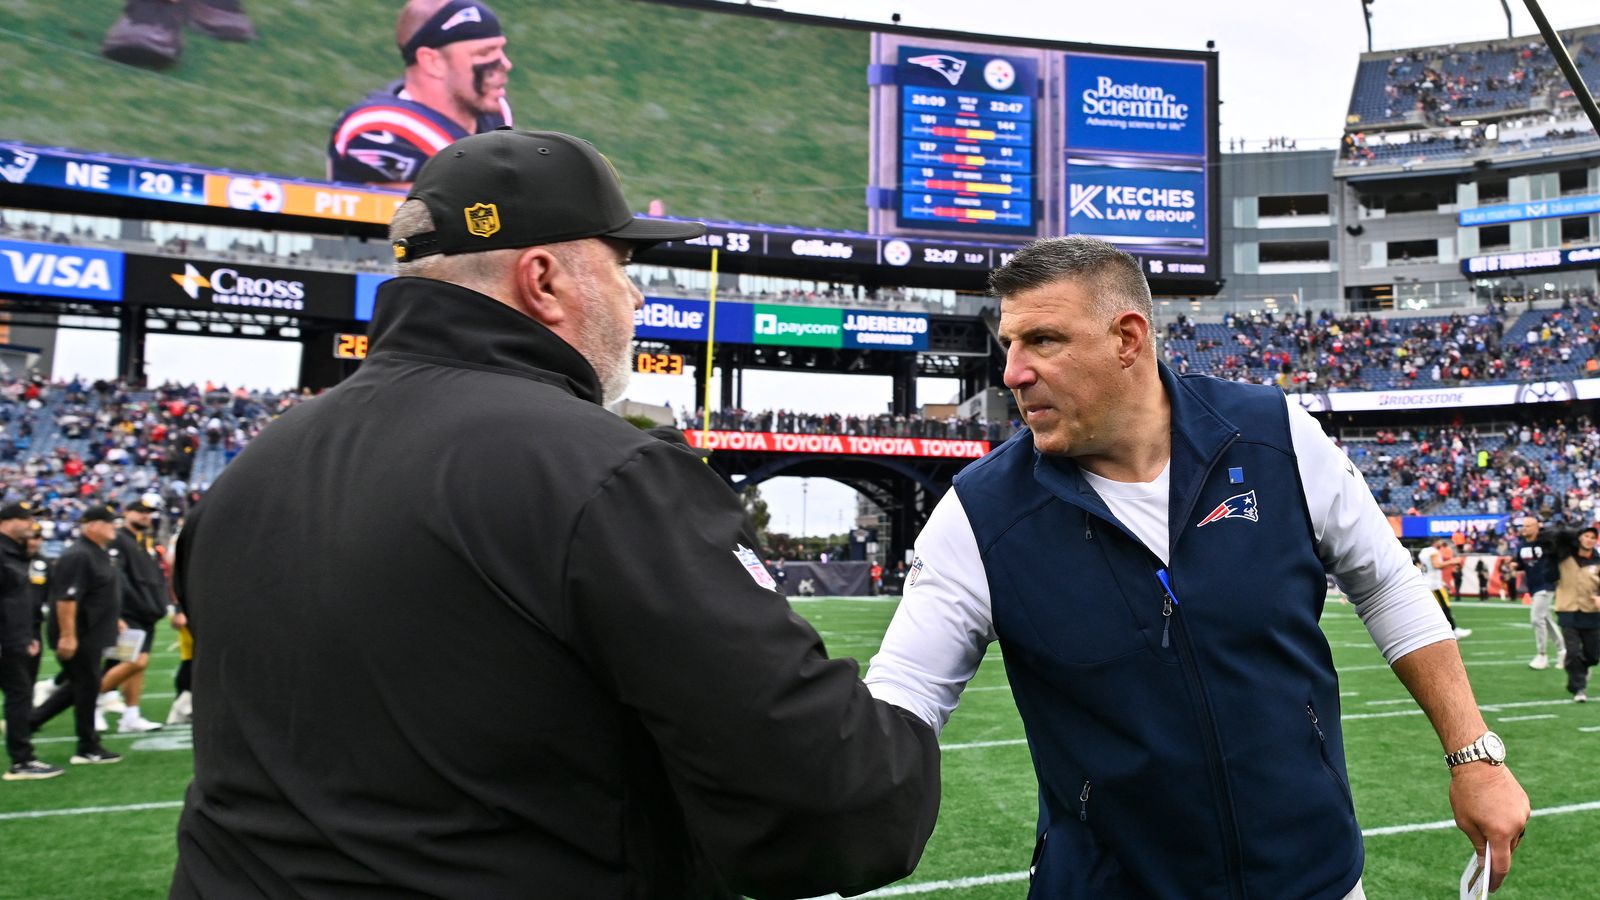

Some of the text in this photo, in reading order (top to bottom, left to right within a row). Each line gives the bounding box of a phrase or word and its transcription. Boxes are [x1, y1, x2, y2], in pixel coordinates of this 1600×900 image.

[1097, 76, 1163, 101] Boston
[990, 101, 1023, 114] 32:47
[1082, 88, 1189, 120] Scientific
[1085, 116, 1127, 130] Advancing
[1128, 120, 1156, 130] science
[1156, 121, 1168, 130] for
[65, 161, 111, 190] NE
[139, 171, 175, 194] 20
[314, 191, 360, 216] PIT
[1106, 185, 1196, 208] KECHES
[1106, 207, 1196, 222] LAW GROUP
[726, 232, 750, 252] 33
[0, 249, 112, 291] VISA
[634, 303, 704, 330] etBlue
[843, 315, 928, 334] J.DERENZO
[777, 321, 840, 336] paycom
[637, 353, 683, 376] 0:23
[1379, 392, 1464, 406] BRIDGESTONE
[692, 430, 984, 458] TOYOTA TOYOTA TOYOTA TOYOTA
